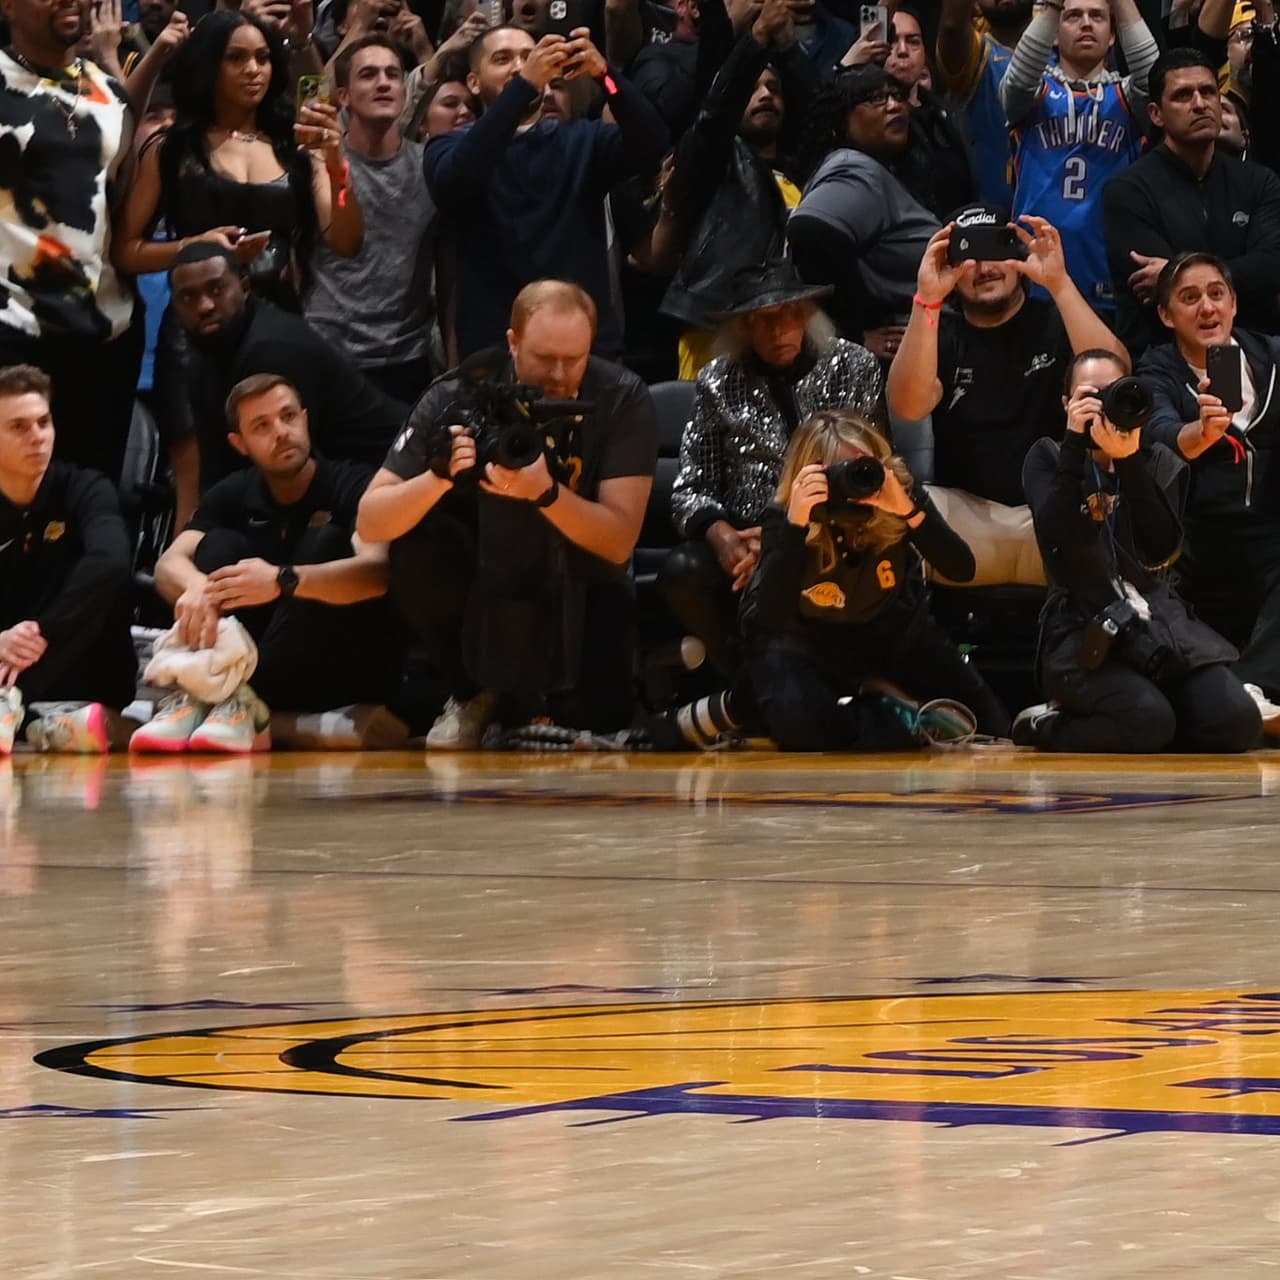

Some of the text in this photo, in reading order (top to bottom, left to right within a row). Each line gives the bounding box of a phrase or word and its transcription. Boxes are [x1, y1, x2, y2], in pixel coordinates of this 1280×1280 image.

[1034, 120, 1126, 154] THUNDER
[1061, 156, 1087, 202] 2
[875, 559, 897, 591] 6
